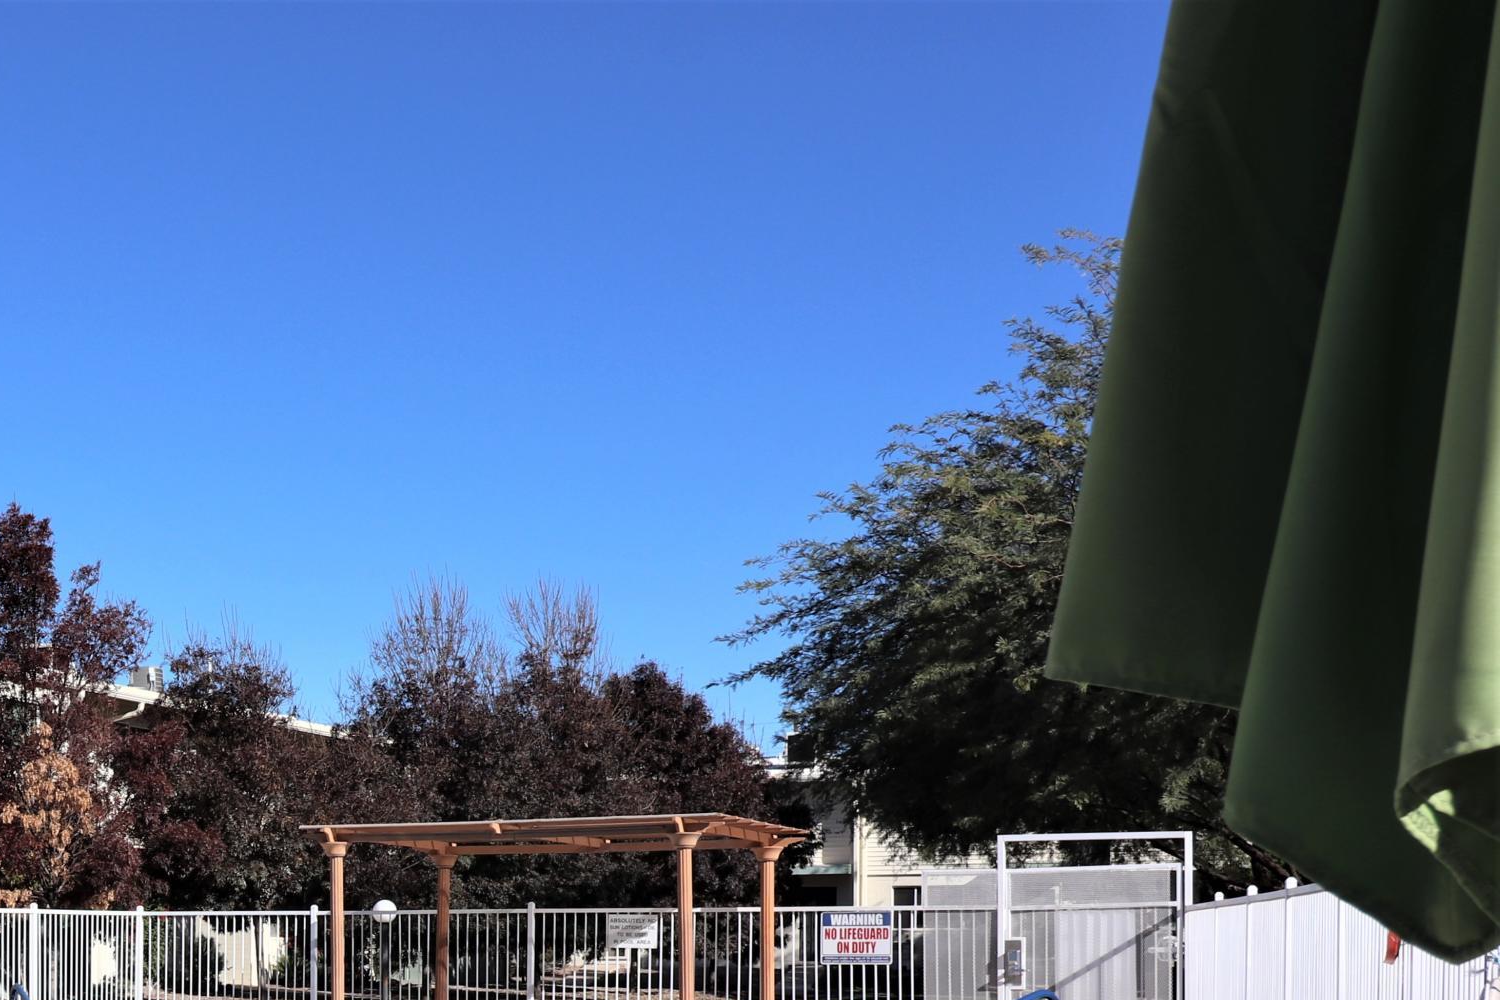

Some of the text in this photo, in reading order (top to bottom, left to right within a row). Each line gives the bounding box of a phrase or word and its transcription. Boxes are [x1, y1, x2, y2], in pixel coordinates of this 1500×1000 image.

[830, 913, 884, 926] WARNING
[824, 927, 889, 940] NO LIFEGUARD
[836, 941, 877, 954] ON DUTY
